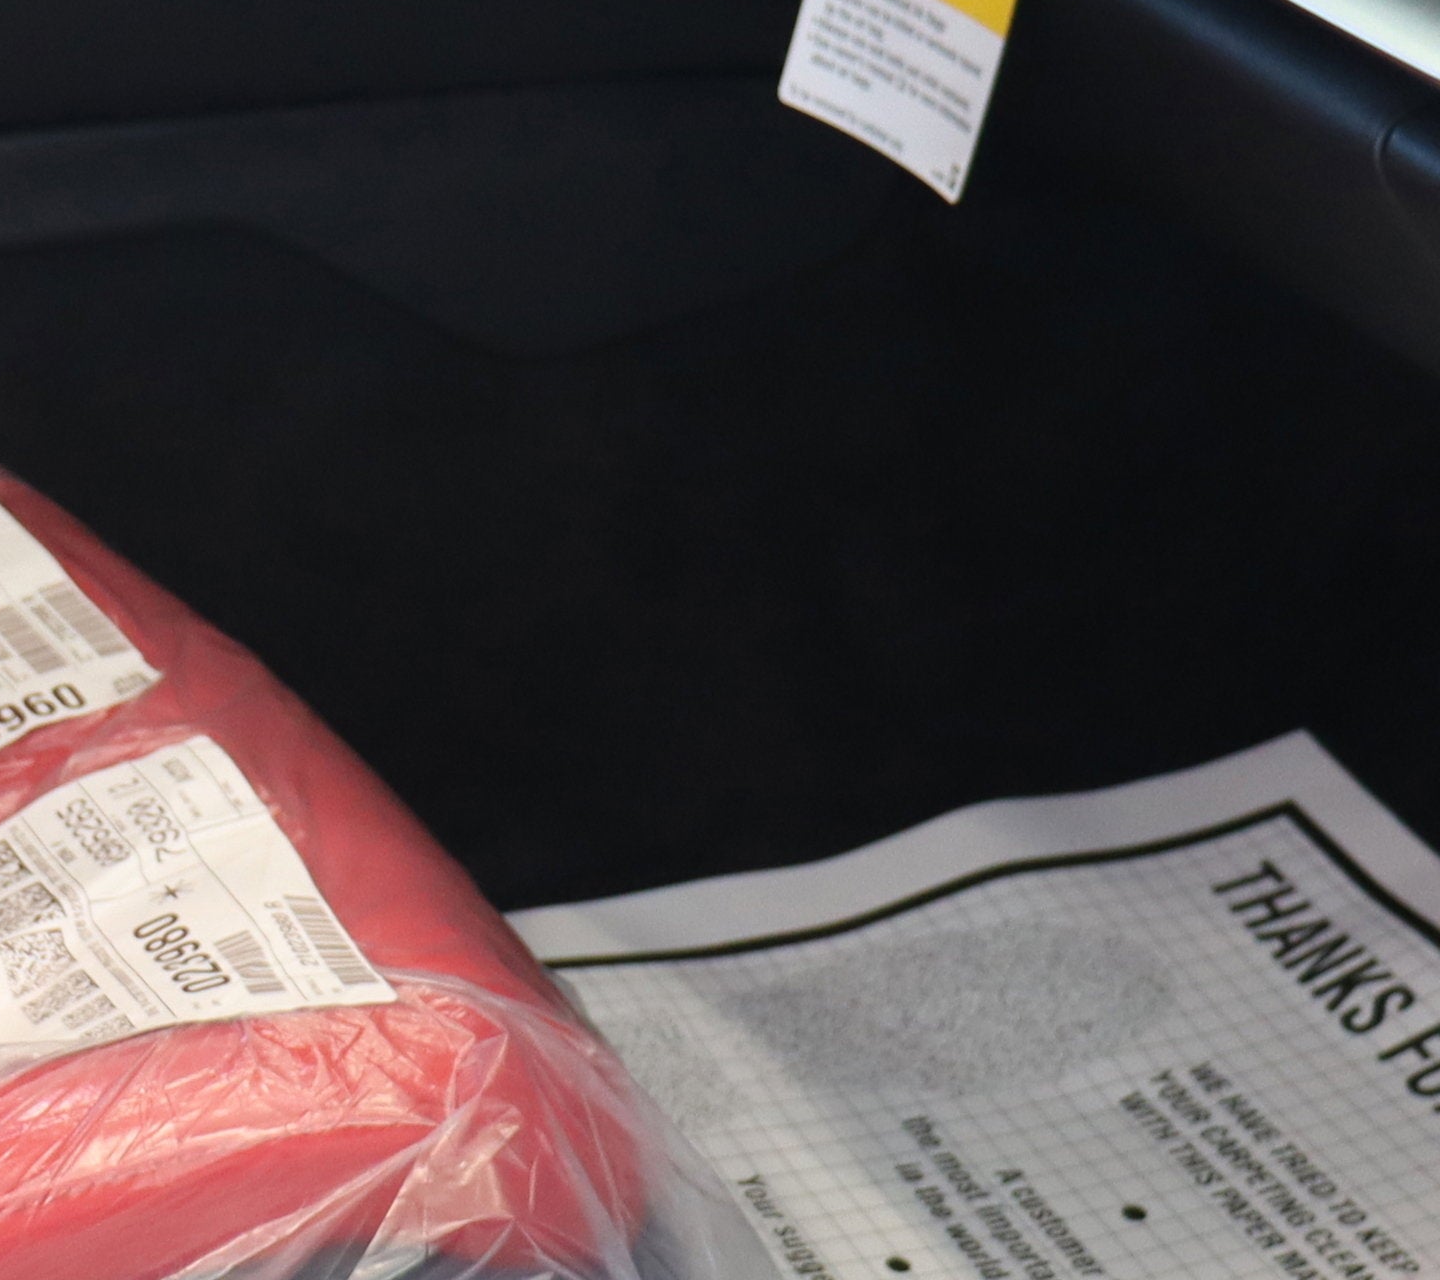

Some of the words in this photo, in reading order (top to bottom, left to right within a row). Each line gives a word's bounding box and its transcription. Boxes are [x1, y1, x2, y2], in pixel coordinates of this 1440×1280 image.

[133, 913, 230, 994] 023980
[1211, 861, 1415, 1035] THANKS
[737, 1173, 784, 1219] Your
[902, 1116, 942, 1148] the
[933, 1151, 990, 1202] most
[1121, 1090, 1181, 1141] WITH
[1170, 1142, 1224, 1186] THIS
[1212, 1186, 1287, 1250] PAPER
[1150, 1070, 1212, 1124] YOUR
[1200, 1125, 1317, 1228] CARPETING
[1190, 1061, 1231, 1093] WE
[1220, 1093, 1281, 1143] HAVE
[1271, 1142, 1328, 1199] TRIED
[1329, 1198, 1367, 1225] TO
[1355, 1227, 1419, 1273] KEEP
[916, 1185, 953, 1219] the
[946, 1223, 1011, 1280] world
[995, 1169, 1024, 1185] A
[1011, 1185, 1105, 1276] customer
